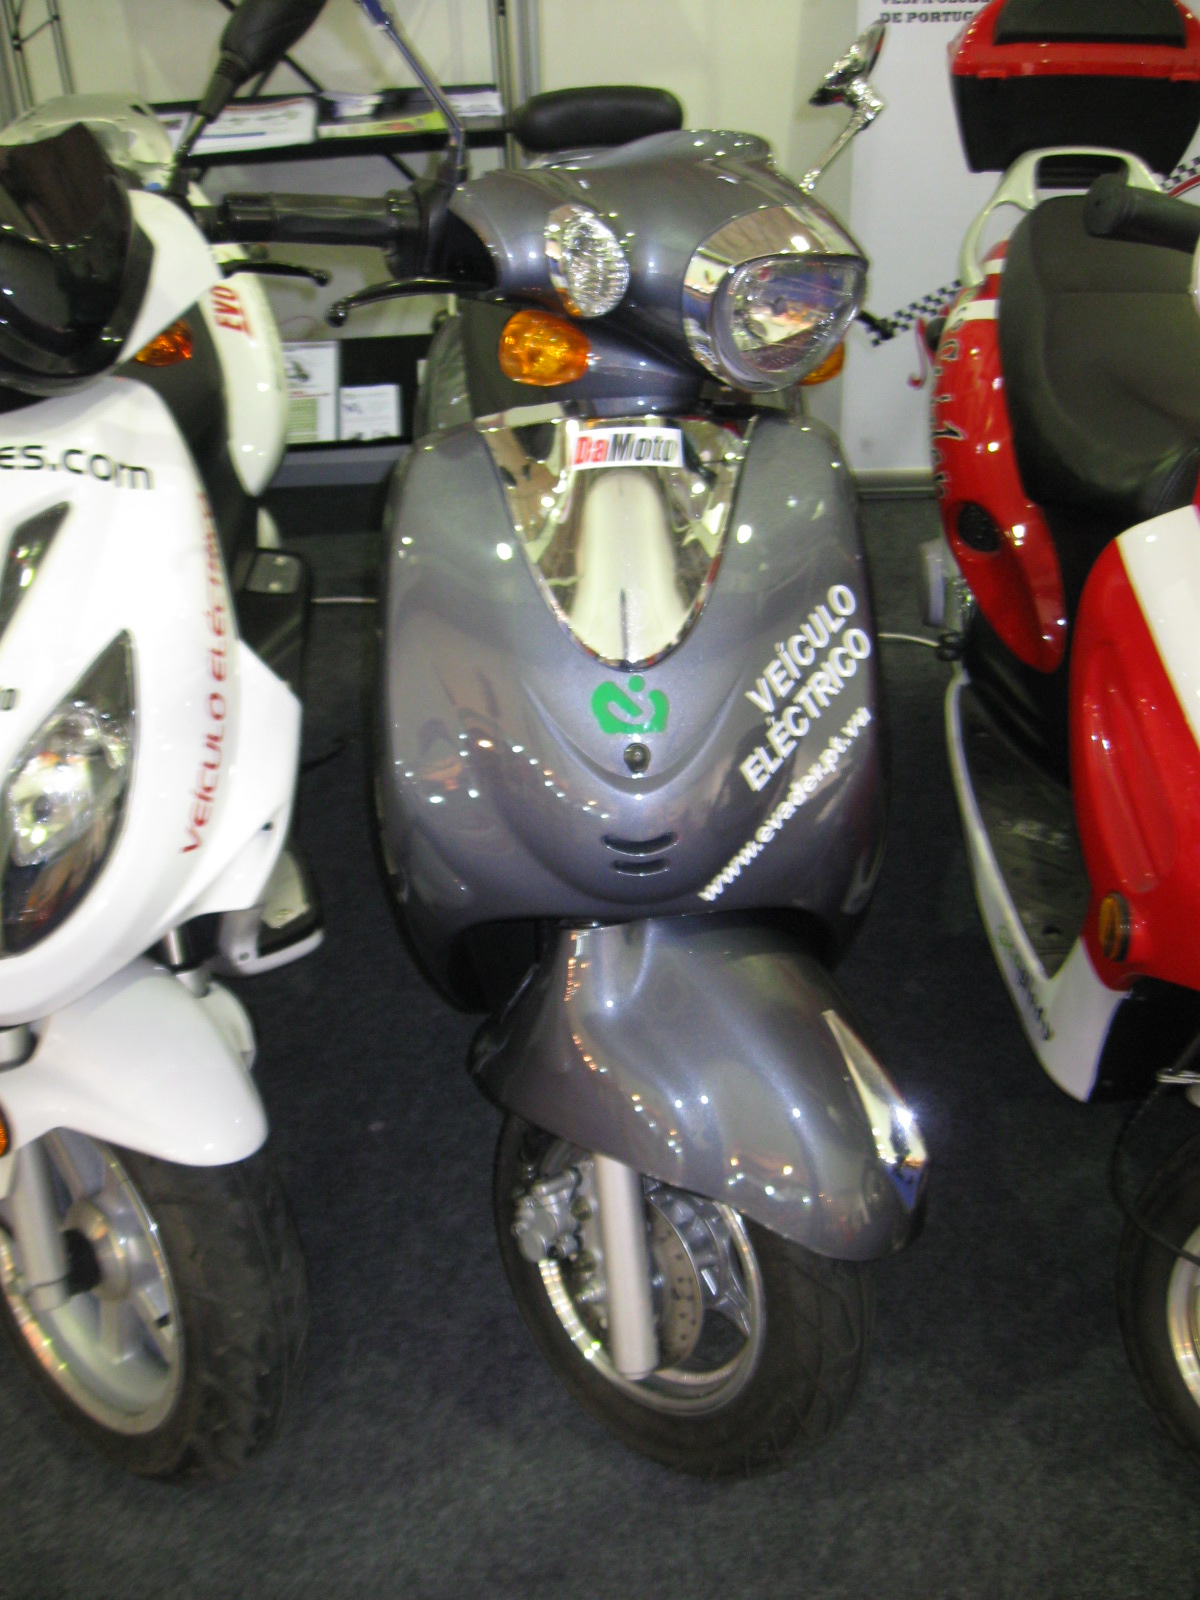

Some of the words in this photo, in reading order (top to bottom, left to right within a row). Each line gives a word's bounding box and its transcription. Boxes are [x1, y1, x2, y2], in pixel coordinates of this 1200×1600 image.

[879, 12, 904, 23] DE
[573, 433, 679, 465] DaMoto
[745, 584, 857, 713] VEÍCULO
[739, 628, 871, 792] ELÉCTRICO
